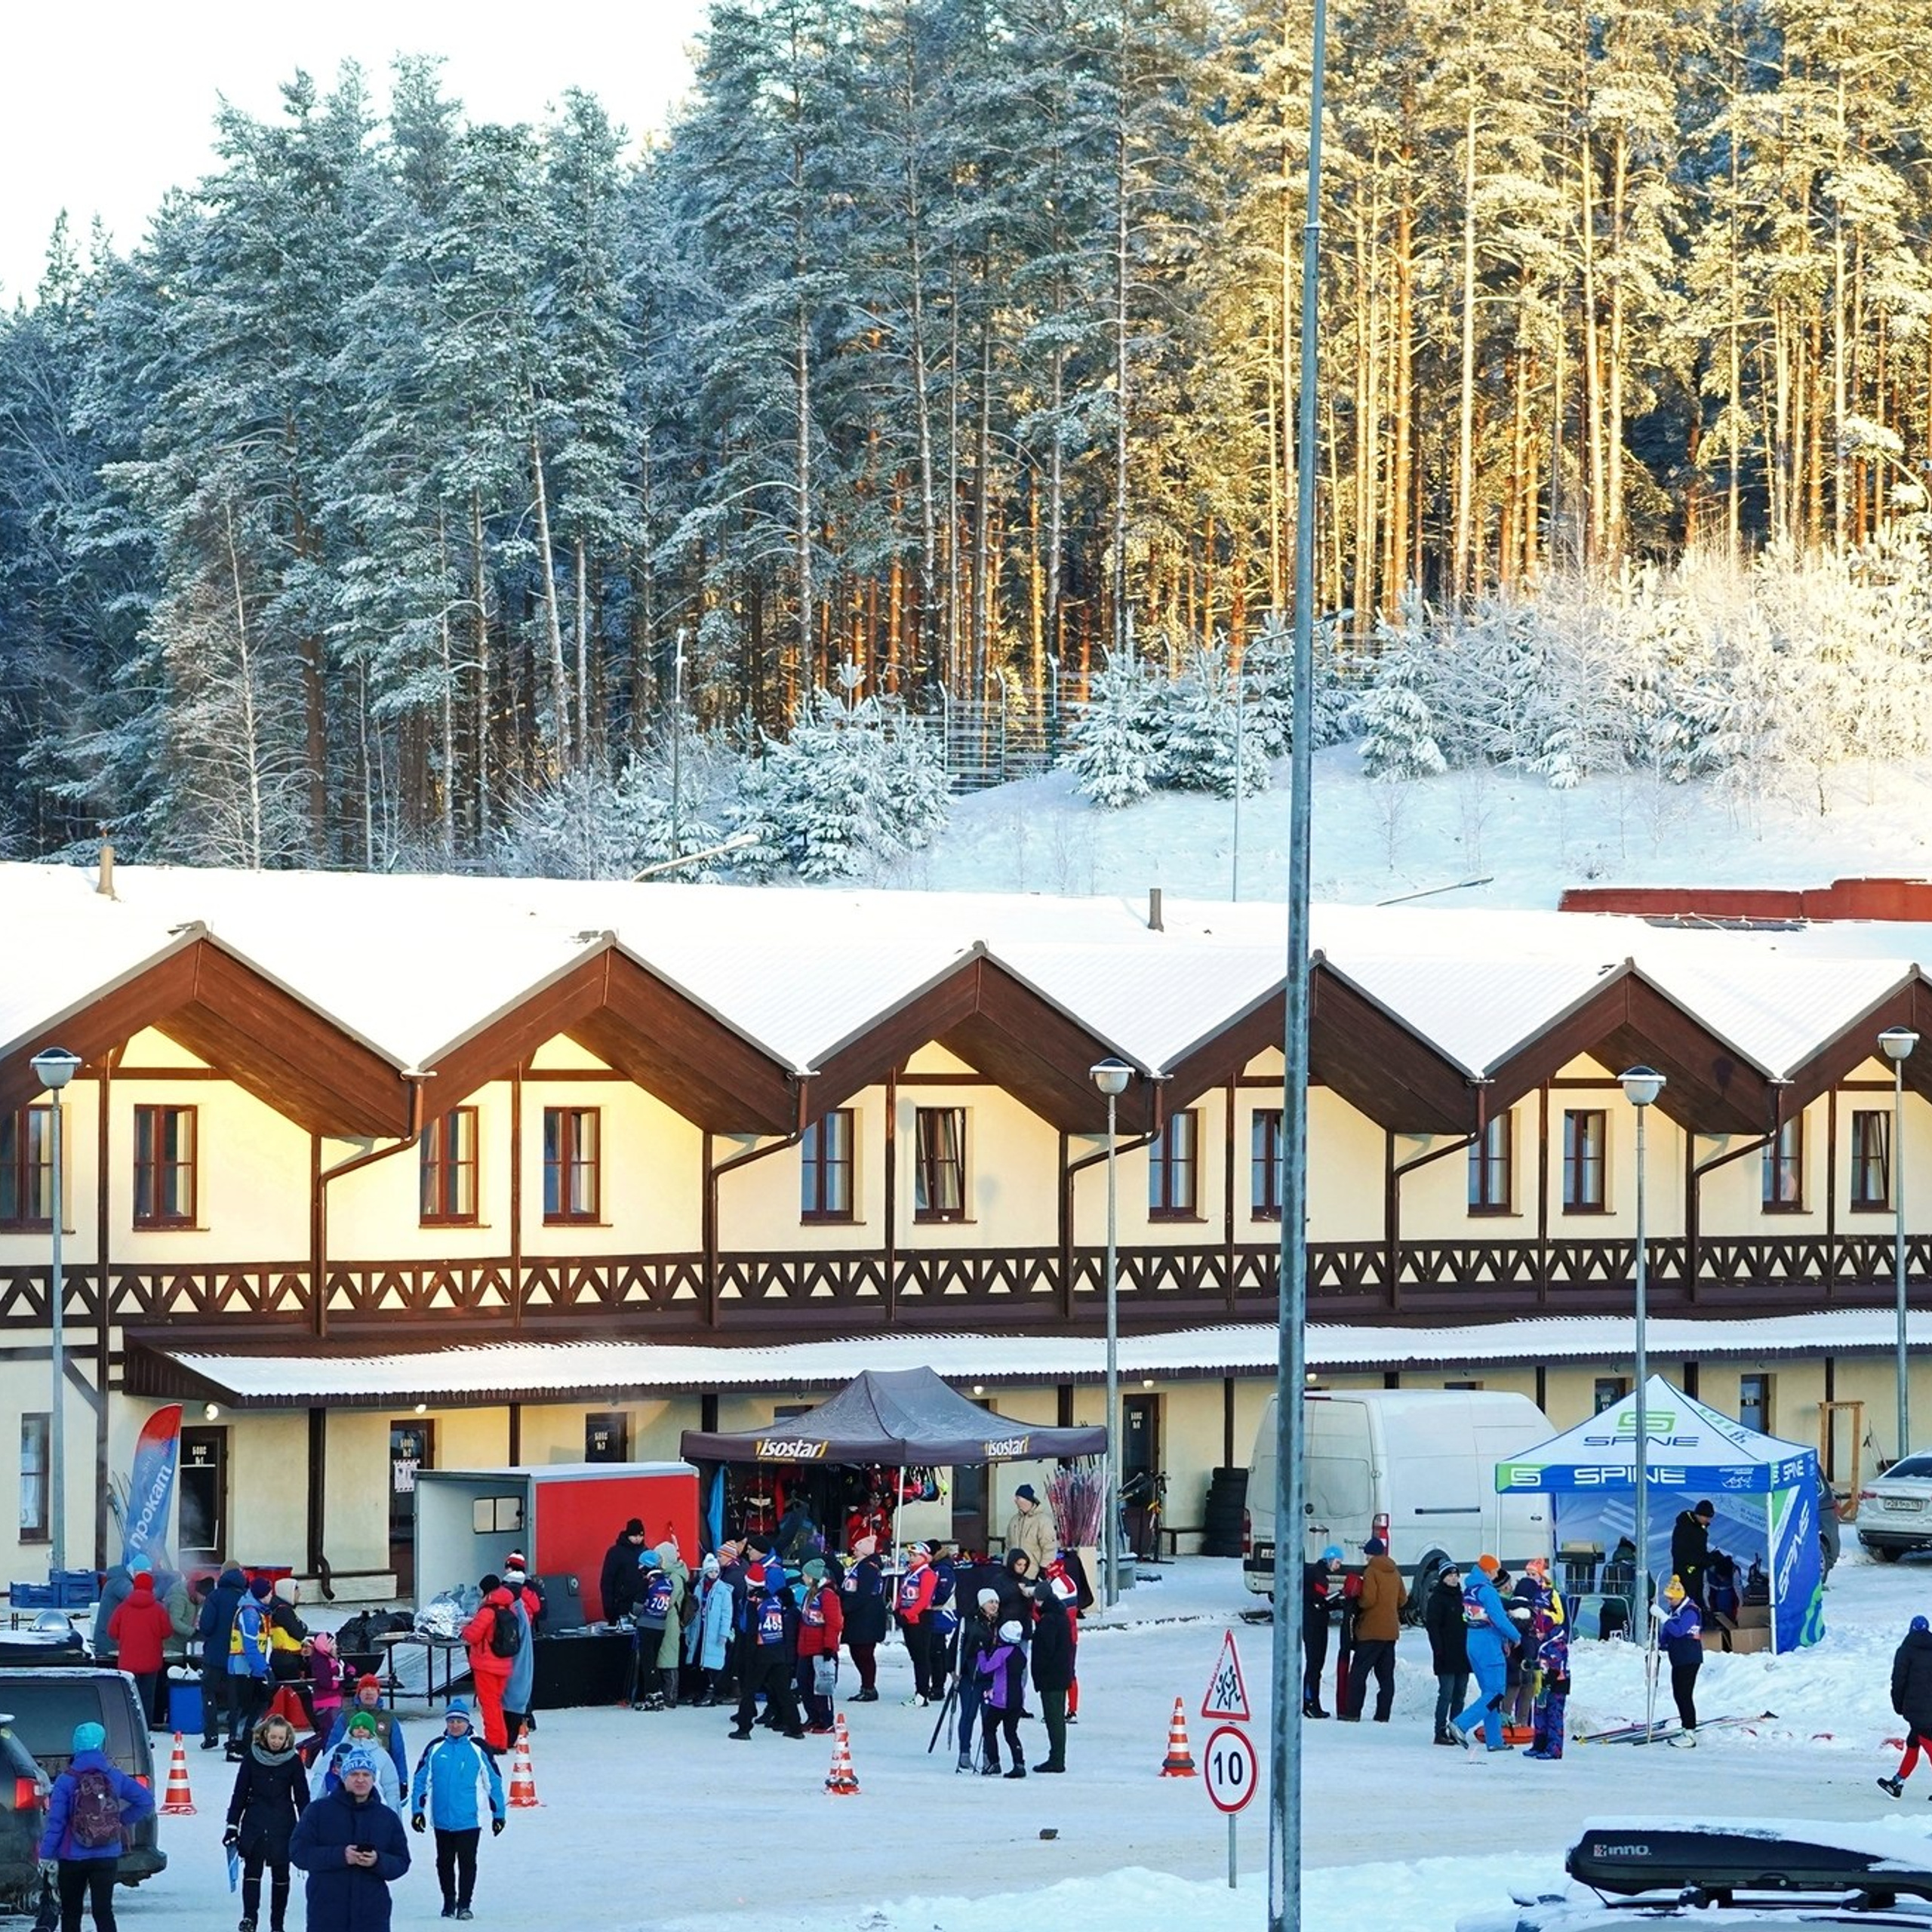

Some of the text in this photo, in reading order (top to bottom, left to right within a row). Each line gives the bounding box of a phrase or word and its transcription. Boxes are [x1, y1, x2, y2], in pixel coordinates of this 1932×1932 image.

[760, 1438, 821, 1457] isostar
[986, 1438, 1025, 1456] isostar
[129, 1465, 173, 1549] прокат
[1214, 1751, 1243, 1786] 10
